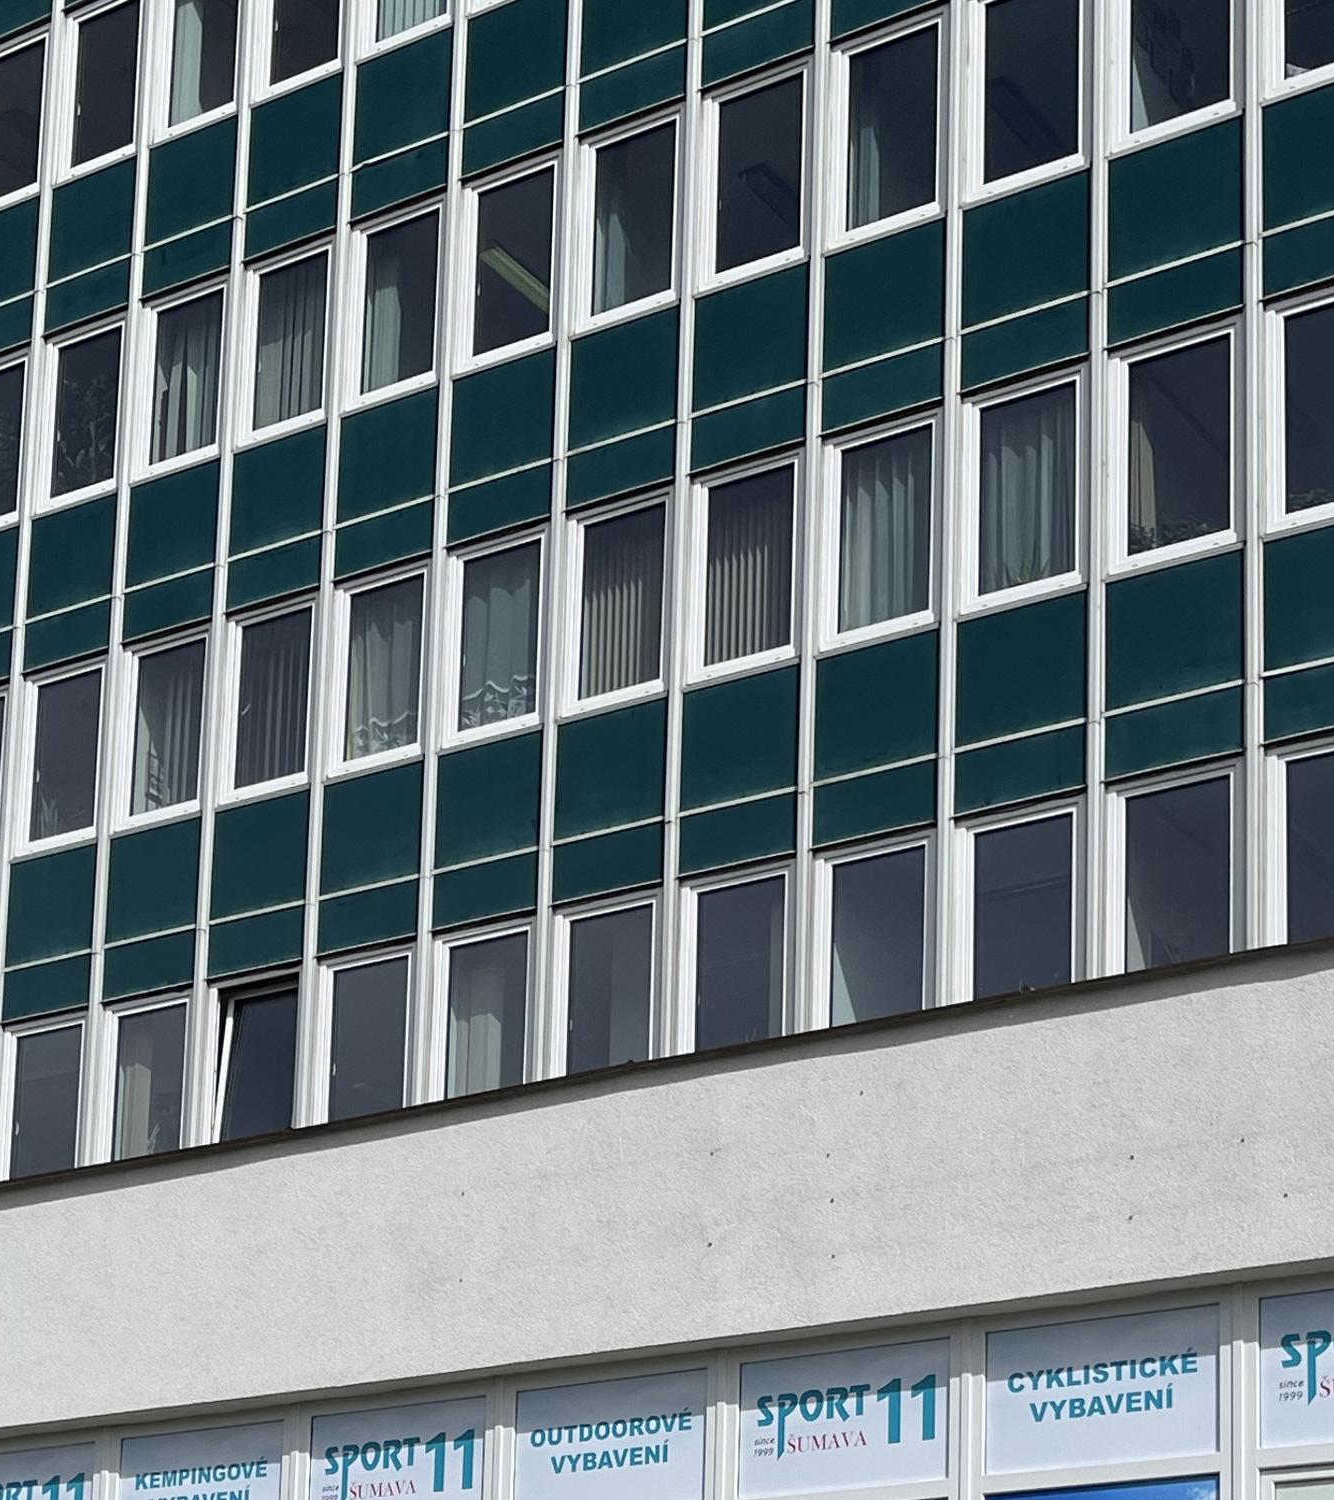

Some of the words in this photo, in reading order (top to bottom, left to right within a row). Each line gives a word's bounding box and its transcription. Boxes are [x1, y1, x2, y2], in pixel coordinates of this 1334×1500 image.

[1007, 1347, 1199, 1393] CYKLISTICKÉ
[1278, 1378, 1305, 1390] since
[1029, 1383, 1174, 1423] VYBAVENÍ
[1277, 1390, 1304, 1402] 1999
[530, 1407, 692, 1447] OUTDOOROVÉ
[756, 1383, 871, 1462] SPORT
[876, 1374, 937, 1444] 11
[753, 1446, 774, 1457] 1999
[754, 1436, 775, 1446] since
[786, 1430, 868, 1455] ŠUMAVA
[424, 1429, 476, 1492] 11
[551, 1440, 670, 1475] VYBAVENÍ
[134, 1460, 268, 1491] KEMPINGOVÉ
[349, 1478, 416, 1500] ŠUMAVA
